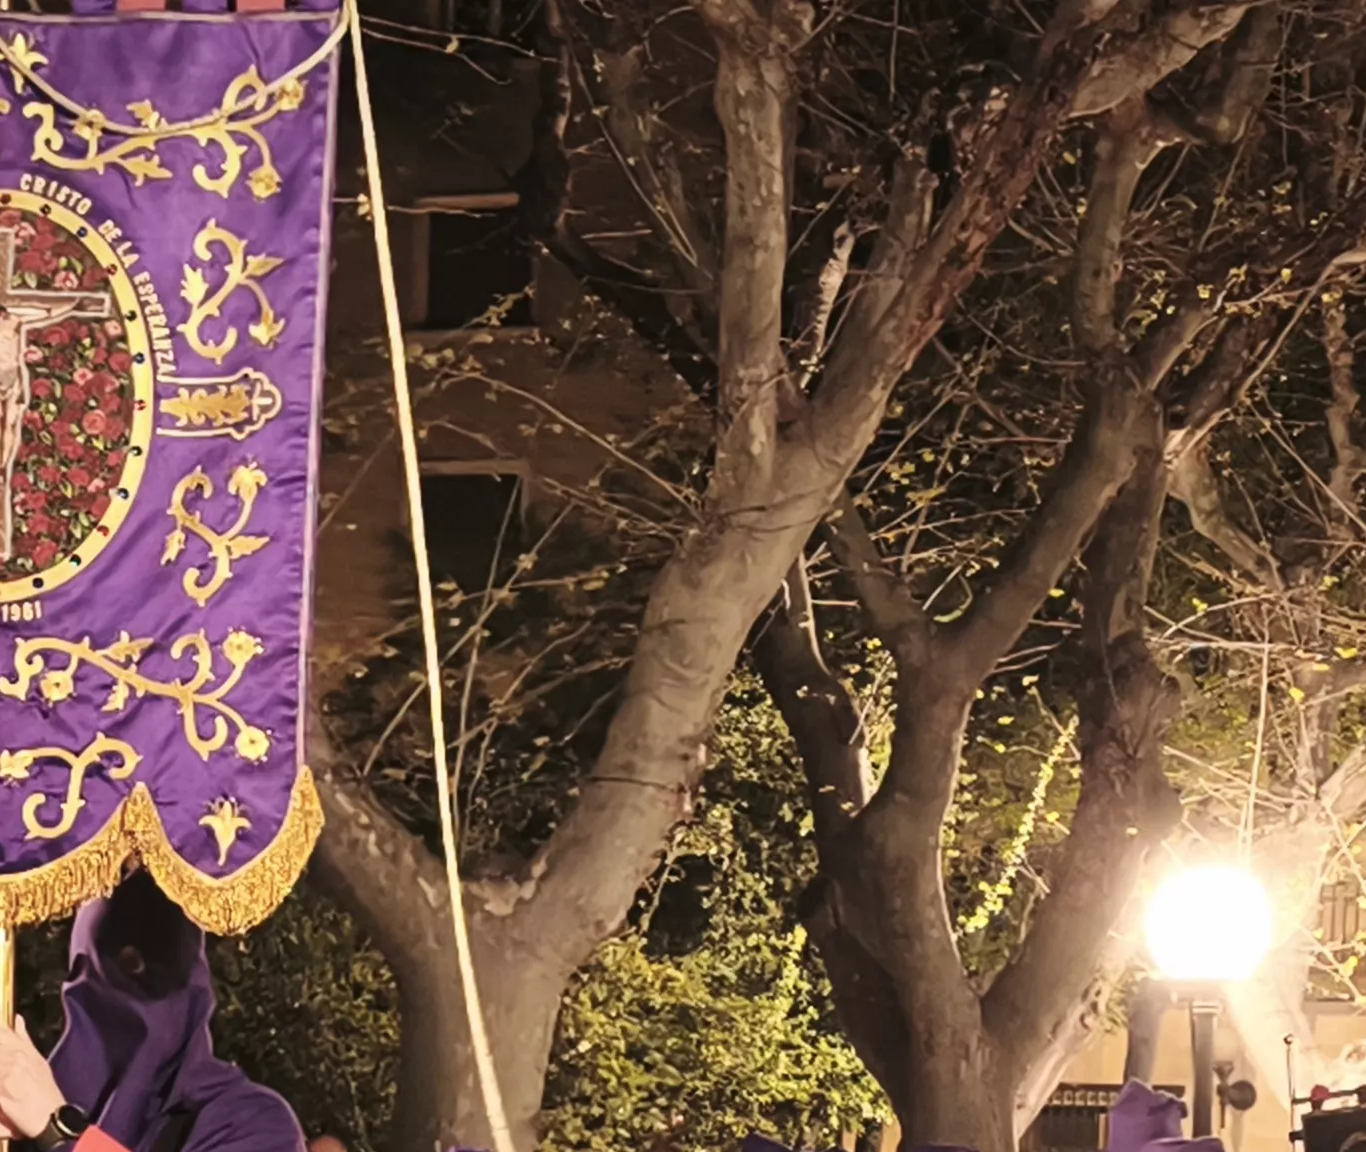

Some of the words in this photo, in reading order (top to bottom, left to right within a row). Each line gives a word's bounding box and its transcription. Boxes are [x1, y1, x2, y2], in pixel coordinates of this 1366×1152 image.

[20, 173, 92, 215] CRISTO
[98, 219, 122, 243] DE
[115, 241, 140, 269] LA
[134, 271, 176, 376] ESPERANZA
